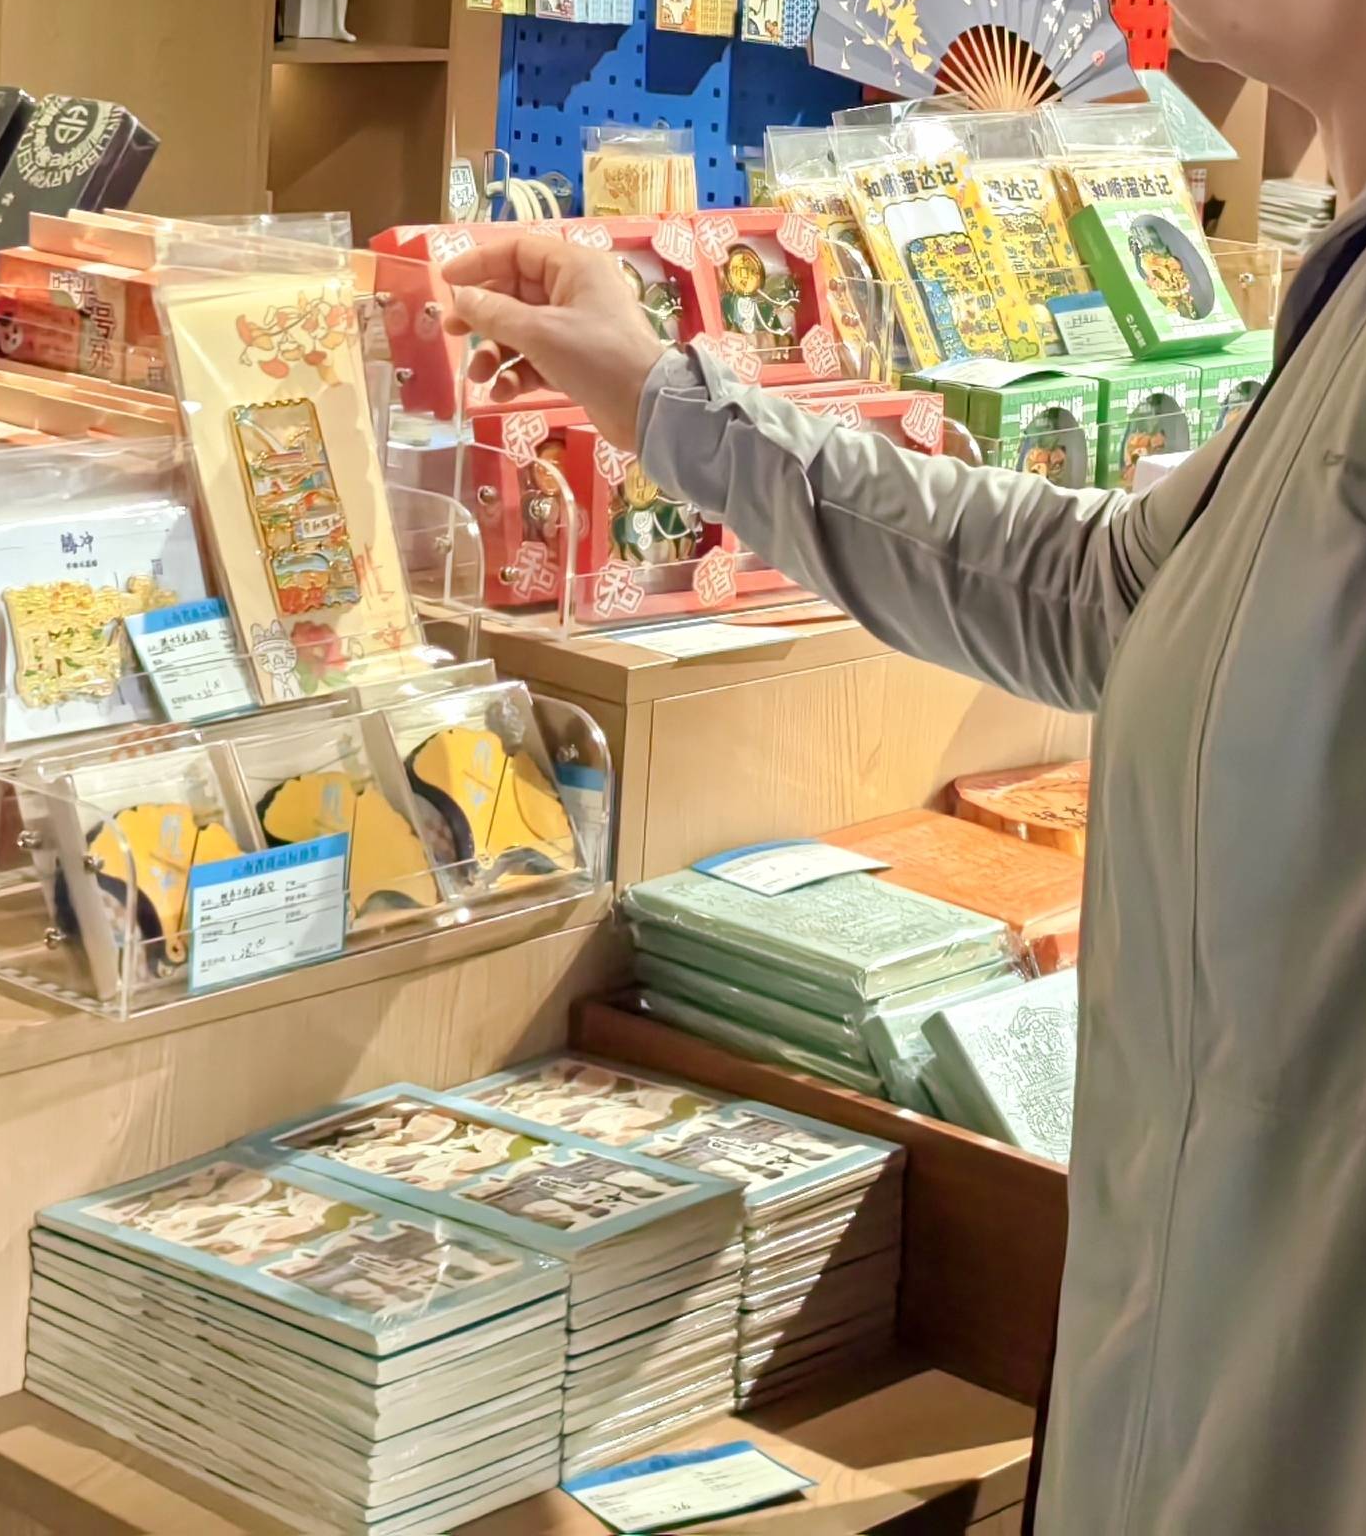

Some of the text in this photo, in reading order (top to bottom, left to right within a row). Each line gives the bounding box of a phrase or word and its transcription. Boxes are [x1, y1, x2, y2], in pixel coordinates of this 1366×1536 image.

[652, 215, 696, 269] 顺
[697, 213, 821, 265] 和 顺
[503, 412, 550, 466] 和
[594, 559, 645, 614] 和
